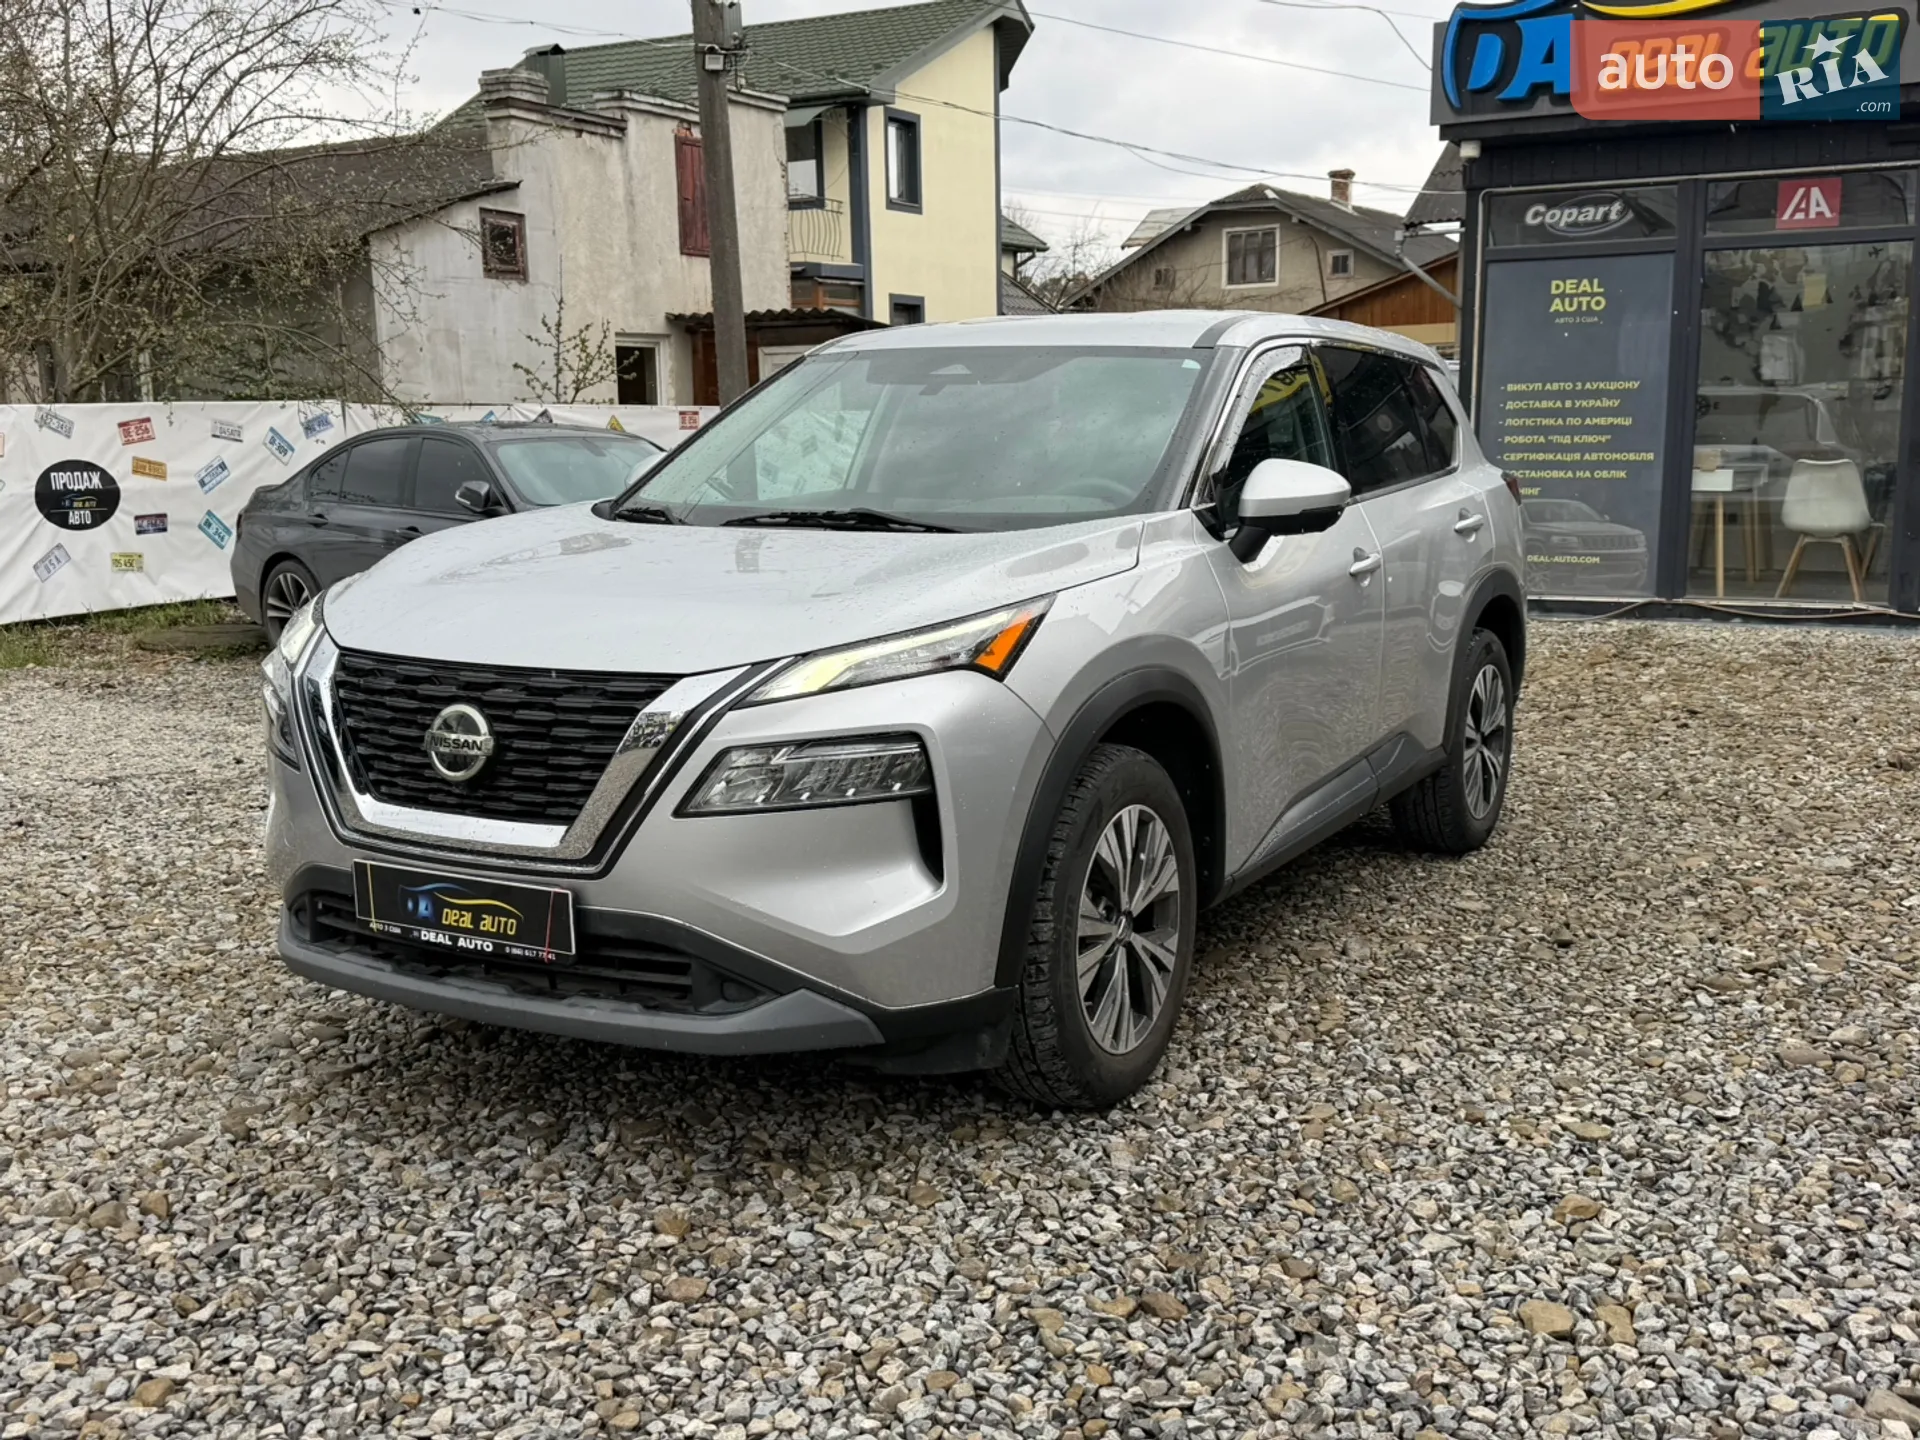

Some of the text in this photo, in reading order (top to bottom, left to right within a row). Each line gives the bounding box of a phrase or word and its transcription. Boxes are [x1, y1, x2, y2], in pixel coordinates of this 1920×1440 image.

[1524, 199, 1622, 228] Copart
[1550, 279, 1604, 294] DEAL
[1549, 296, 1606, 312] AUTO
[1506, 383, 1542, 392] ВИКУП
[1544, 382, 1573, 391] АВТО
[1584, 380, 1640, 391] АУКЦІОНУ
[1505, 397, 1621, 410] ДОСТАВКА В УКРАЇНУ
[1504, 416, 1632, 426] ЛОГІСТИКА ПО АМЕРИЦІ
[1504, 435, 1545, 444] РОБОТА
[1503, 452, 1655, 462] СЕРТИФІКАЦІЯ АВТОМОБІЛЯ
[50, 471, 103, 491] ПРОДАЖ
[1576, 470, 1591, 478] НА
[1594, 470, 1627, 478] ОБЛІК
[68, 510, 92, 525] АВТО
[1526, 555, 1600, 564] DEAL-AUTO.COM
[431, 734, 482, 751] NISSAN
[421, 930, 452, 945] DEAL
[457, 937, 493, 952] AUTO
